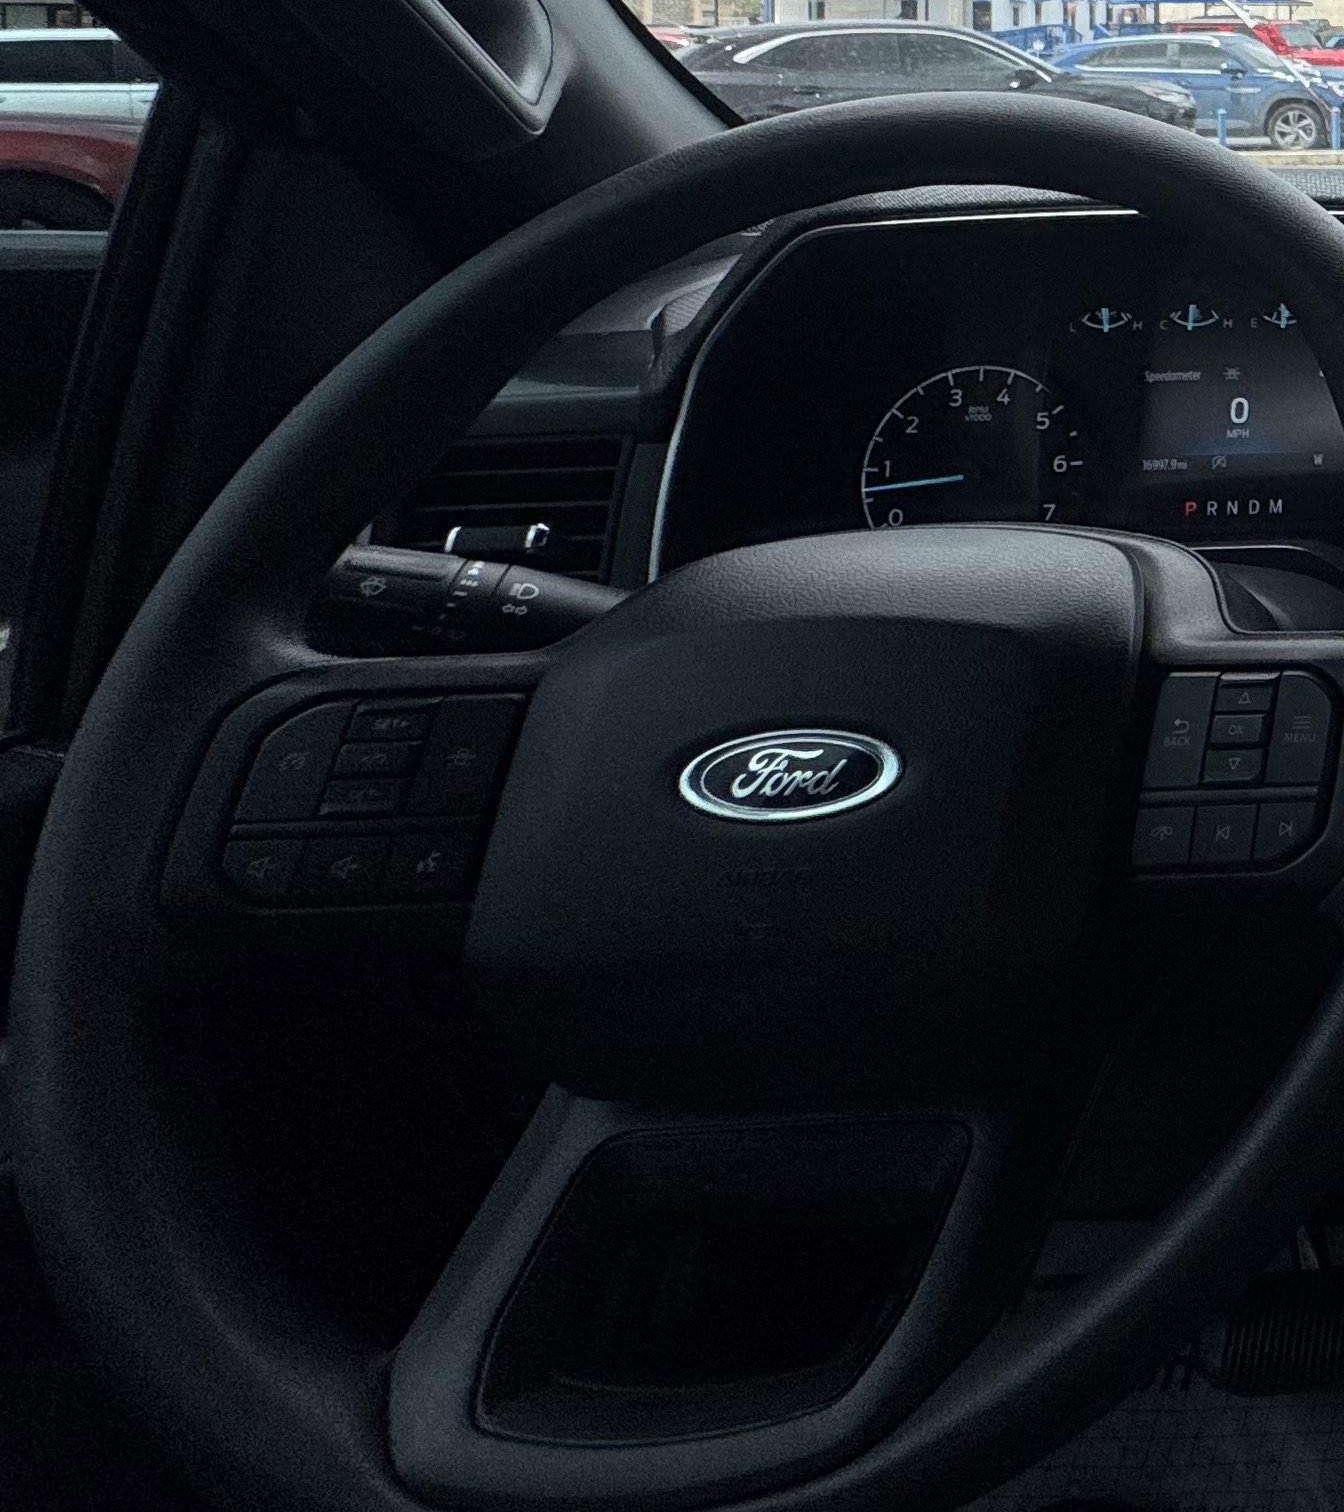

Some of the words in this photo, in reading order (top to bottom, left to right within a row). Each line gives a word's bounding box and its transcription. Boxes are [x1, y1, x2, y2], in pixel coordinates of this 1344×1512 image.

[1131, 320, 1144, 331] H
[1159, 320, 1170, 331] C
[1222, 318, 1233, 329] H
[1249, 318, 1259, 329] E
[1144, 369, 1202, 384] Speedometer
[947, 388, 964, 408] 3
[995, 387, 1012, 406] 4
[967, 405, 990, 414] RPM
[1229, 396, 1250, 425] 0
[904, 415, 920, 435] 2
[1034, 412, 1051, 431] 5
[1226, 429, 1250, 439] MPH
[883, 459, 892, 479] 1
[1051, 453, 1069, 474] 6
[1313, 454, 1325, 467] W
[887, 507, 904, 527] 0
[1041, 502, 1057, 522] 7
[1184, 502, 1198, 517] P
[1206, 501, 1218, 516] R
[1226, 500, 1240, 515] N
[1248, 499, 1261, 515] D
[1268, 498, 1284, 515] M
[1164, 735, 1192, 748] BACK
[1228, 724, 1243, 736] OK
[1284, 732, 1317, 743] MENU
[731, 747, 847, 803] Ford
